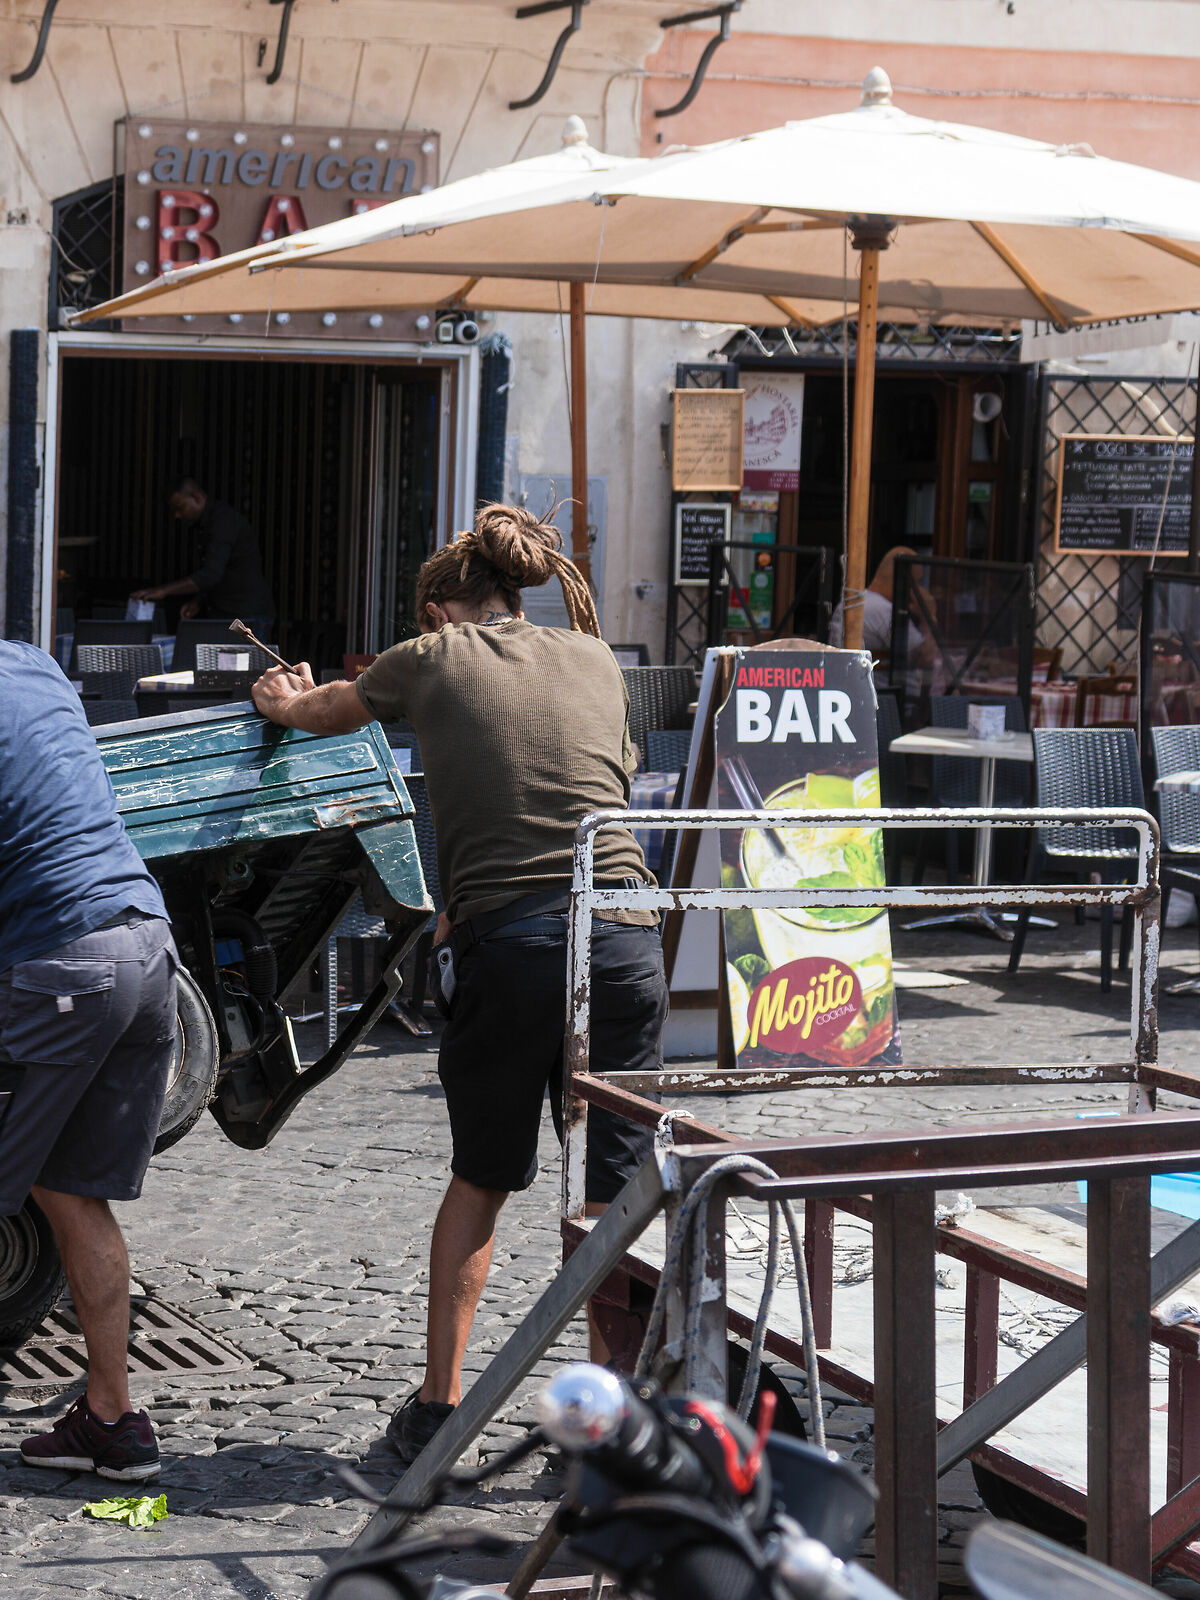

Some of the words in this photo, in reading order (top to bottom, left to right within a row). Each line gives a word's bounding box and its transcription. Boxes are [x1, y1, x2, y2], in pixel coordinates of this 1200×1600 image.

[152, 144, 416, 194] american
[155, 189, 397, 276] BA
[737, 667, 825, 687] AMERICAN
[736, 689, 857, 743] BAR
[749, 963, 855, 1048] Mojito
[815, 1003, 857, 1027] COCKTAIL
